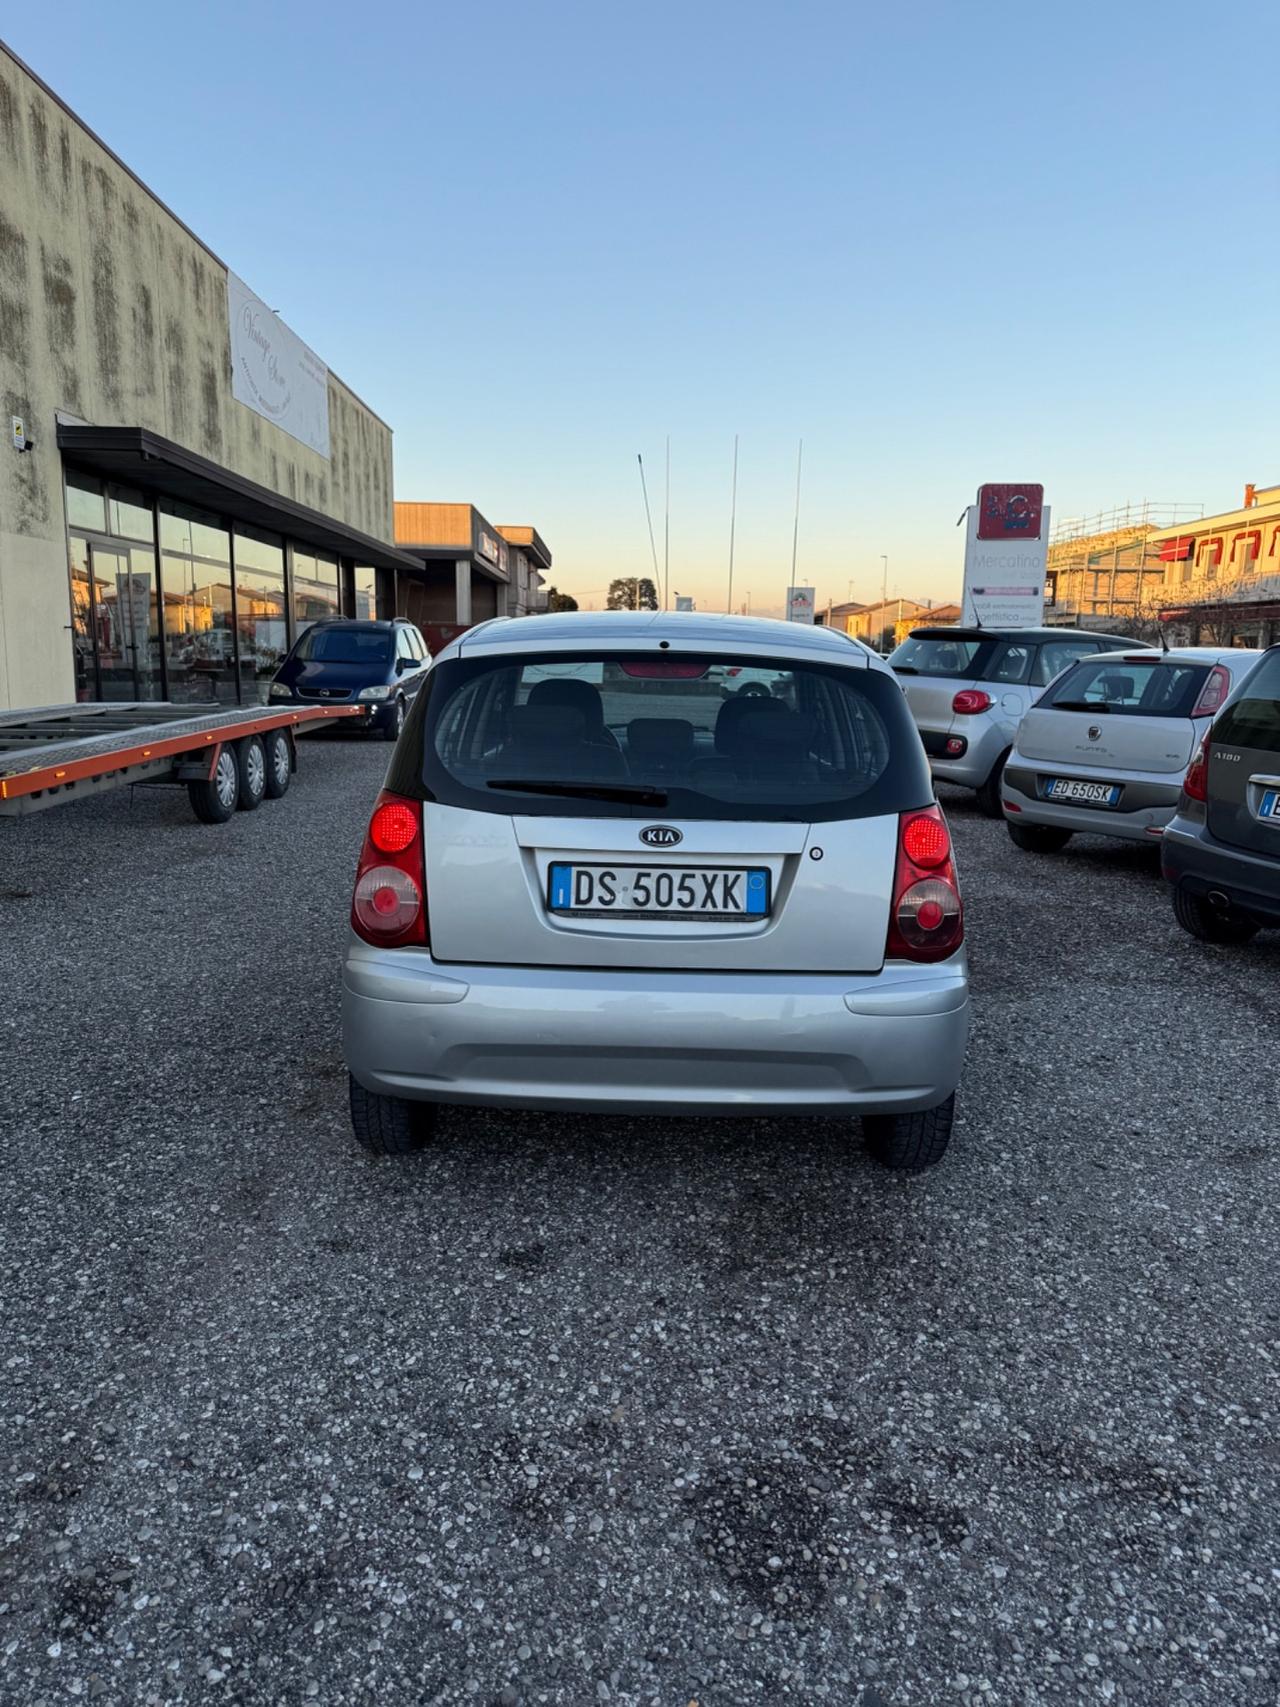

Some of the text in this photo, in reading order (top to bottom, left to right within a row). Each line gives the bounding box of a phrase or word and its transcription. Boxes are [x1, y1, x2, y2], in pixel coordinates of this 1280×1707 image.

[972, 553, 1041, 569] Mercatino
[1053, 780, 1070, 794] ED
[1071, 782, 1112, 801] 650SK
[647, 830, 675, 842] KIA
[574, 870, 617, 907] DS
[632, 872, 742, 910] 505XK
